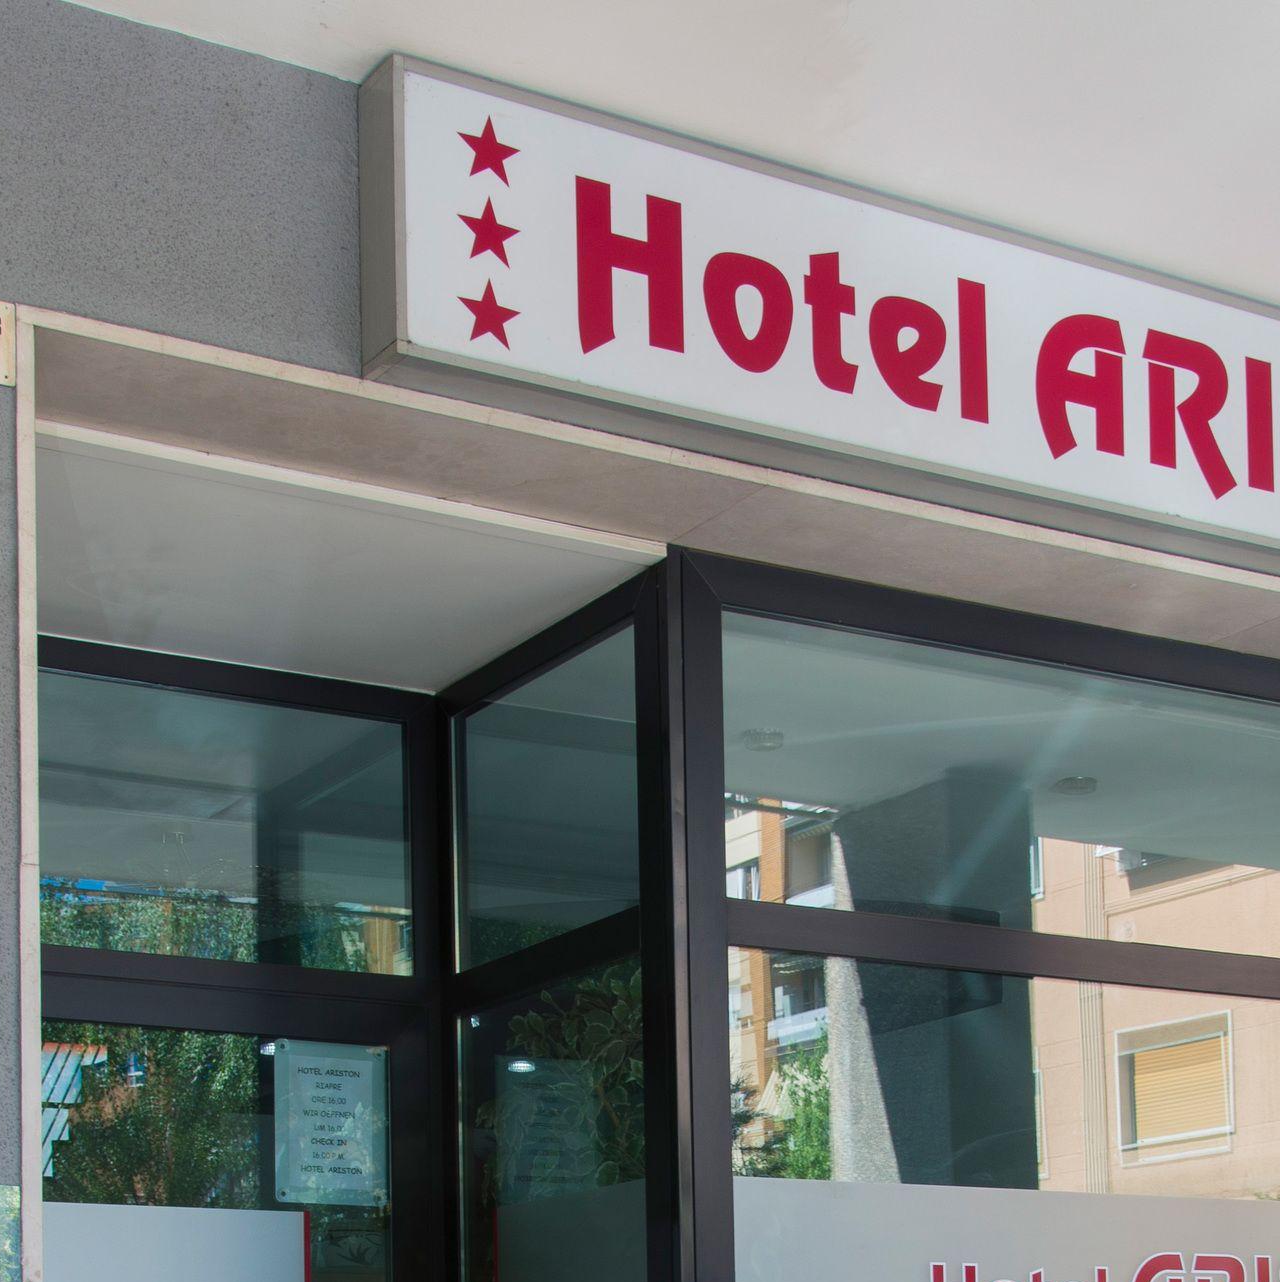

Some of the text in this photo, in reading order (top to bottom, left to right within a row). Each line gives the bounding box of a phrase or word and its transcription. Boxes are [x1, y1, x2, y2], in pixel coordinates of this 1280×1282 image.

[576, 175, 988, 425] Hotel
[297, 1066, 360, 1078] HOTEL ARISTON
[303, 1109, 318, 1117] WIR
[300, 1164, 363, 1175] HOTEL ARISTON
